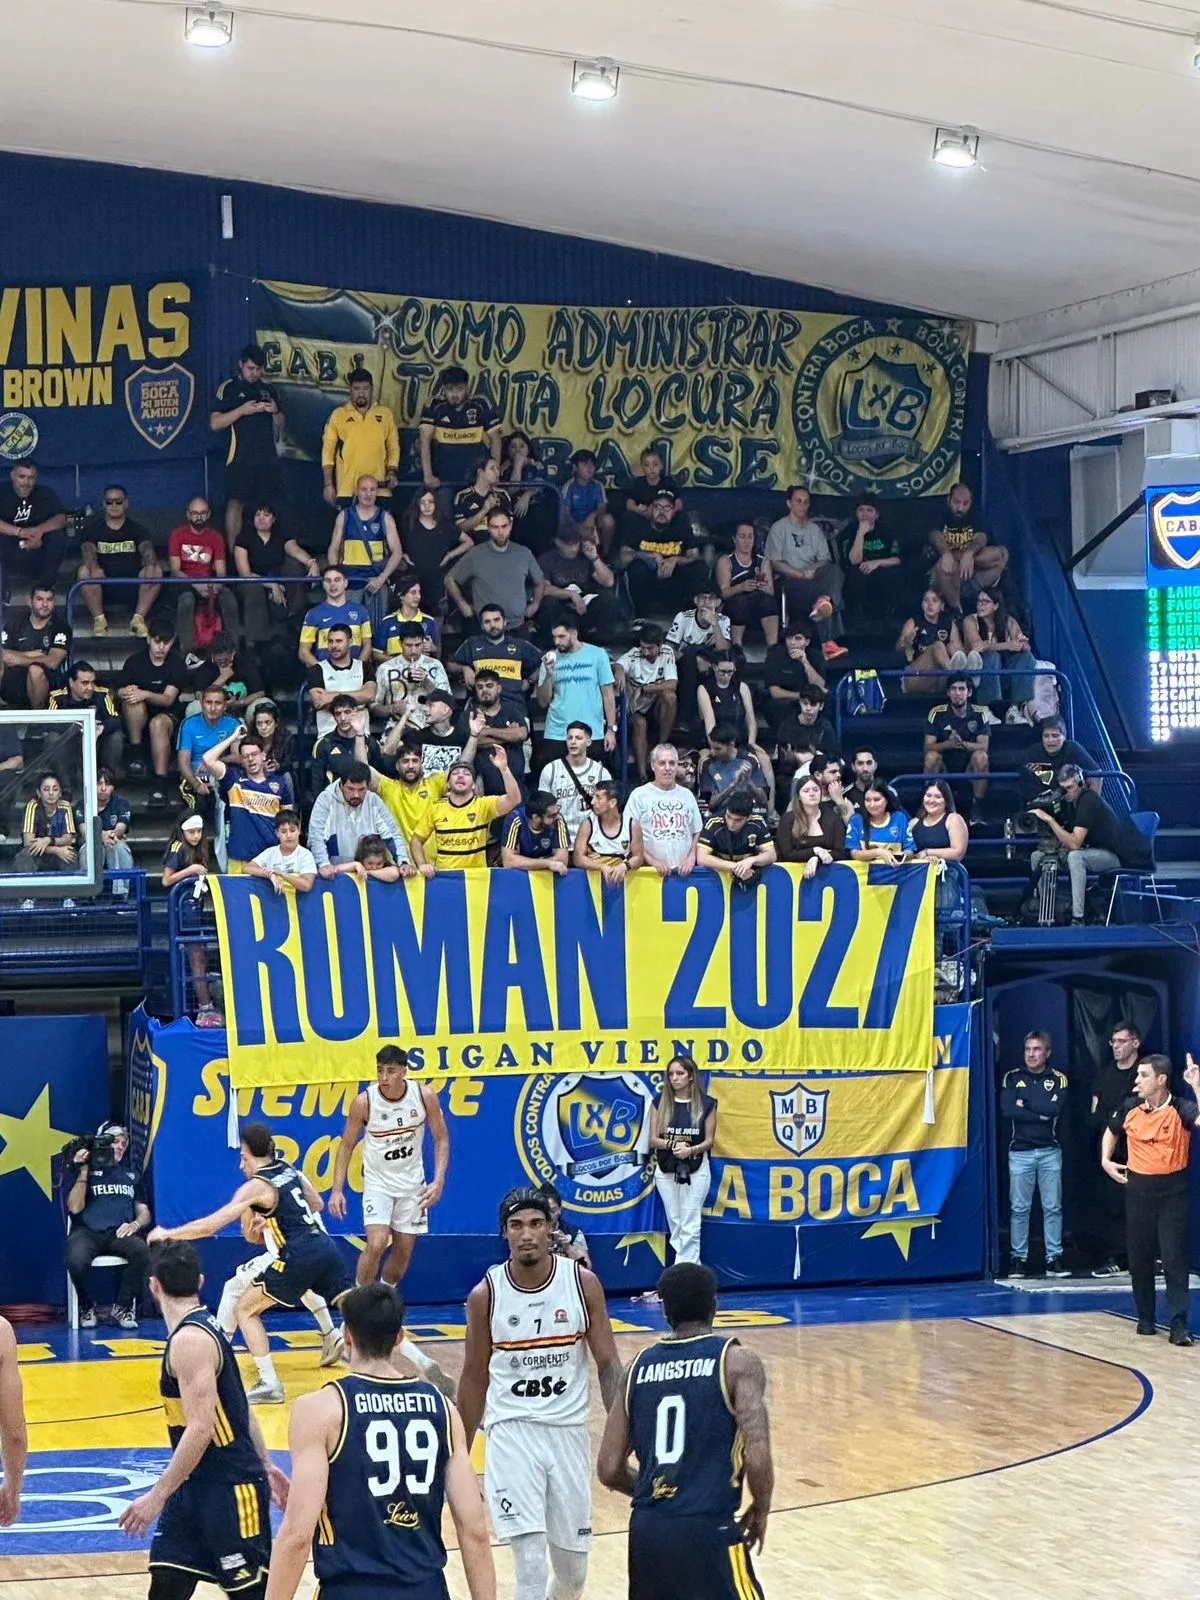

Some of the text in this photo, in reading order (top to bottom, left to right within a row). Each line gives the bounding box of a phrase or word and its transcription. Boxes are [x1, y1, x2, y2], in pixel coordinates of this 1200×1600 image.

[393, 297, 801, 372] COMO ADMINISTRAR
[4, 364, 113, 408] BROWN
[141, 385, 180, 400] BOCA
[396, 362, 781, 430] TNTA LOCURA
[141, 406, 179, 419] AMIGO
[796, 318, 876, 493] TODOS CONTRA BOCA
[948, 363, 968, 441] CONTRA
[896, 446, 955, 497] TODOS
[1166, 519, 1200, 533] CAB
[1148, 587, 1159, 599] 0
[1149, 600, 1159, 612] 3
[1150, 701, 1169, 714] 44
[218, 862, 929, 1047] ROMAN 2027
[406, 1038, 763, 1071] SIGAN VIENDO
[781, 1098, 817, 1114] M B
[396, 1117, 404, 1127] 8
[782, 1124, 817, 1141] Q M
[527, 1136, 559, 1187] TODOS
[598, 1157, 612, 1169] por
[574, 1187, 624, 1203] LOMAS
[701, 1158, 921, 1222] A BOCA
[290, 1186, 315, 1225] 5
[533, 1318, 542, 1335] 7
[522, 1352, 570, 1366] CORRIENTES
[636, 1358, 716, 1385] LANGSTON
[510, 1375, 568, 1398] CBSé
[354, 1392, 438, 1414] GIORGETTI
[654, 1394, 686, 1465] 0
[365, 1419, 439, 1497] 99
